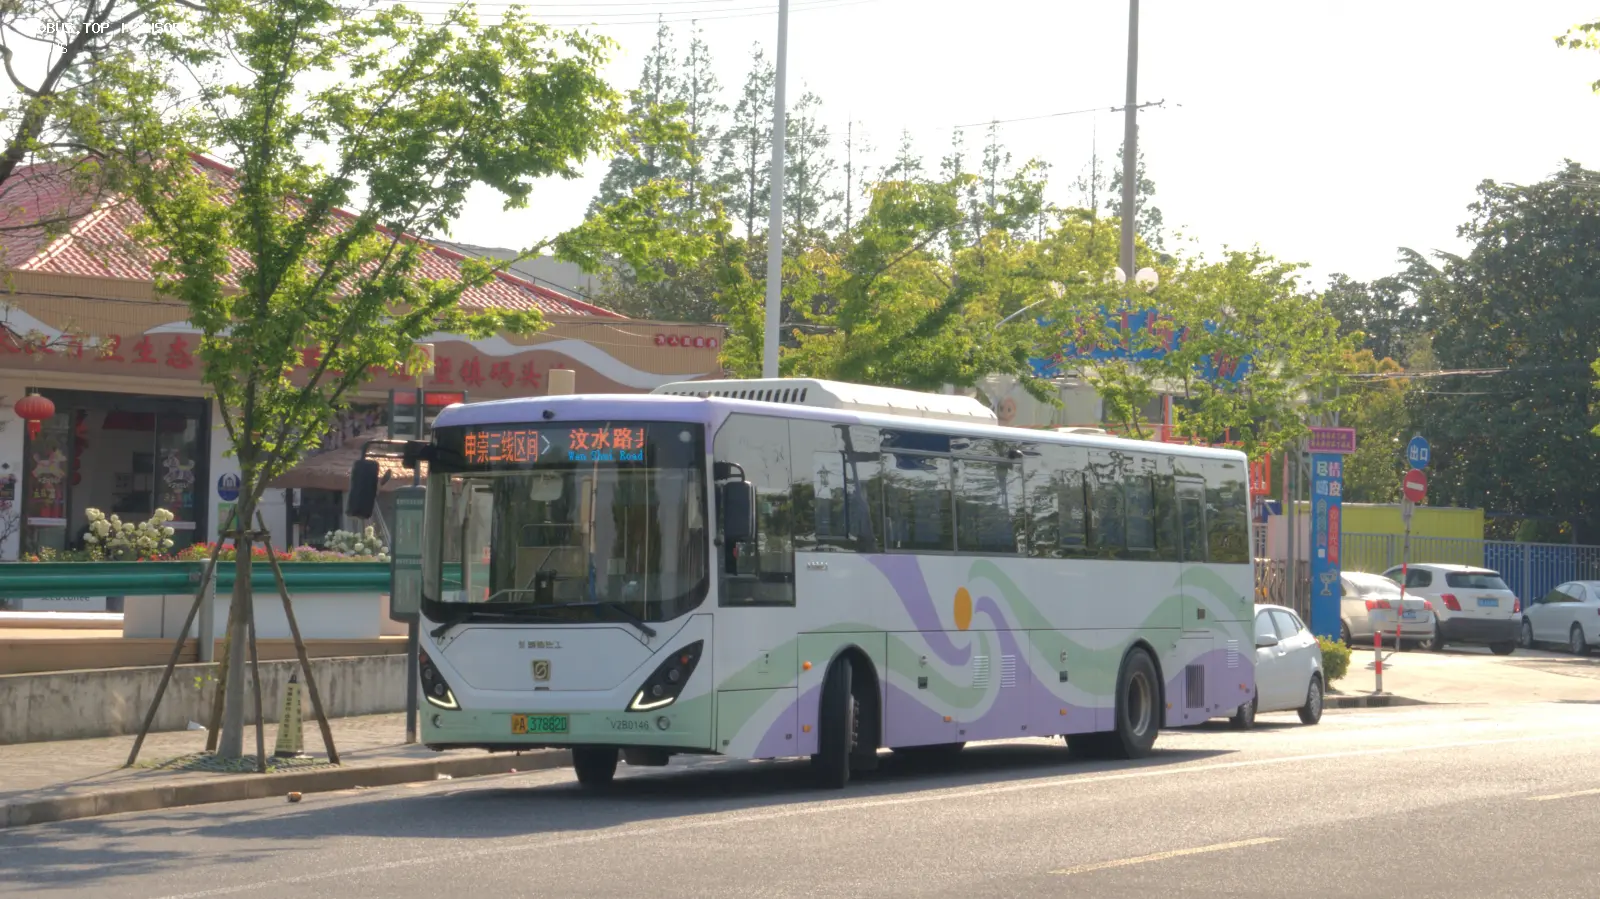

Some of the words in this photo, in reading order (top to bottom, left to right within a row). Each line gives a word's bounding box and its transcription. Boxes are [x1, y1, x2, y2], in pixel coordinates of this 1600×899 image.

[464, 430, 538, 464] 申崇三线区间
[620, 448, 644, 461] Road
[1410, 444, 1428, 462] 出口
